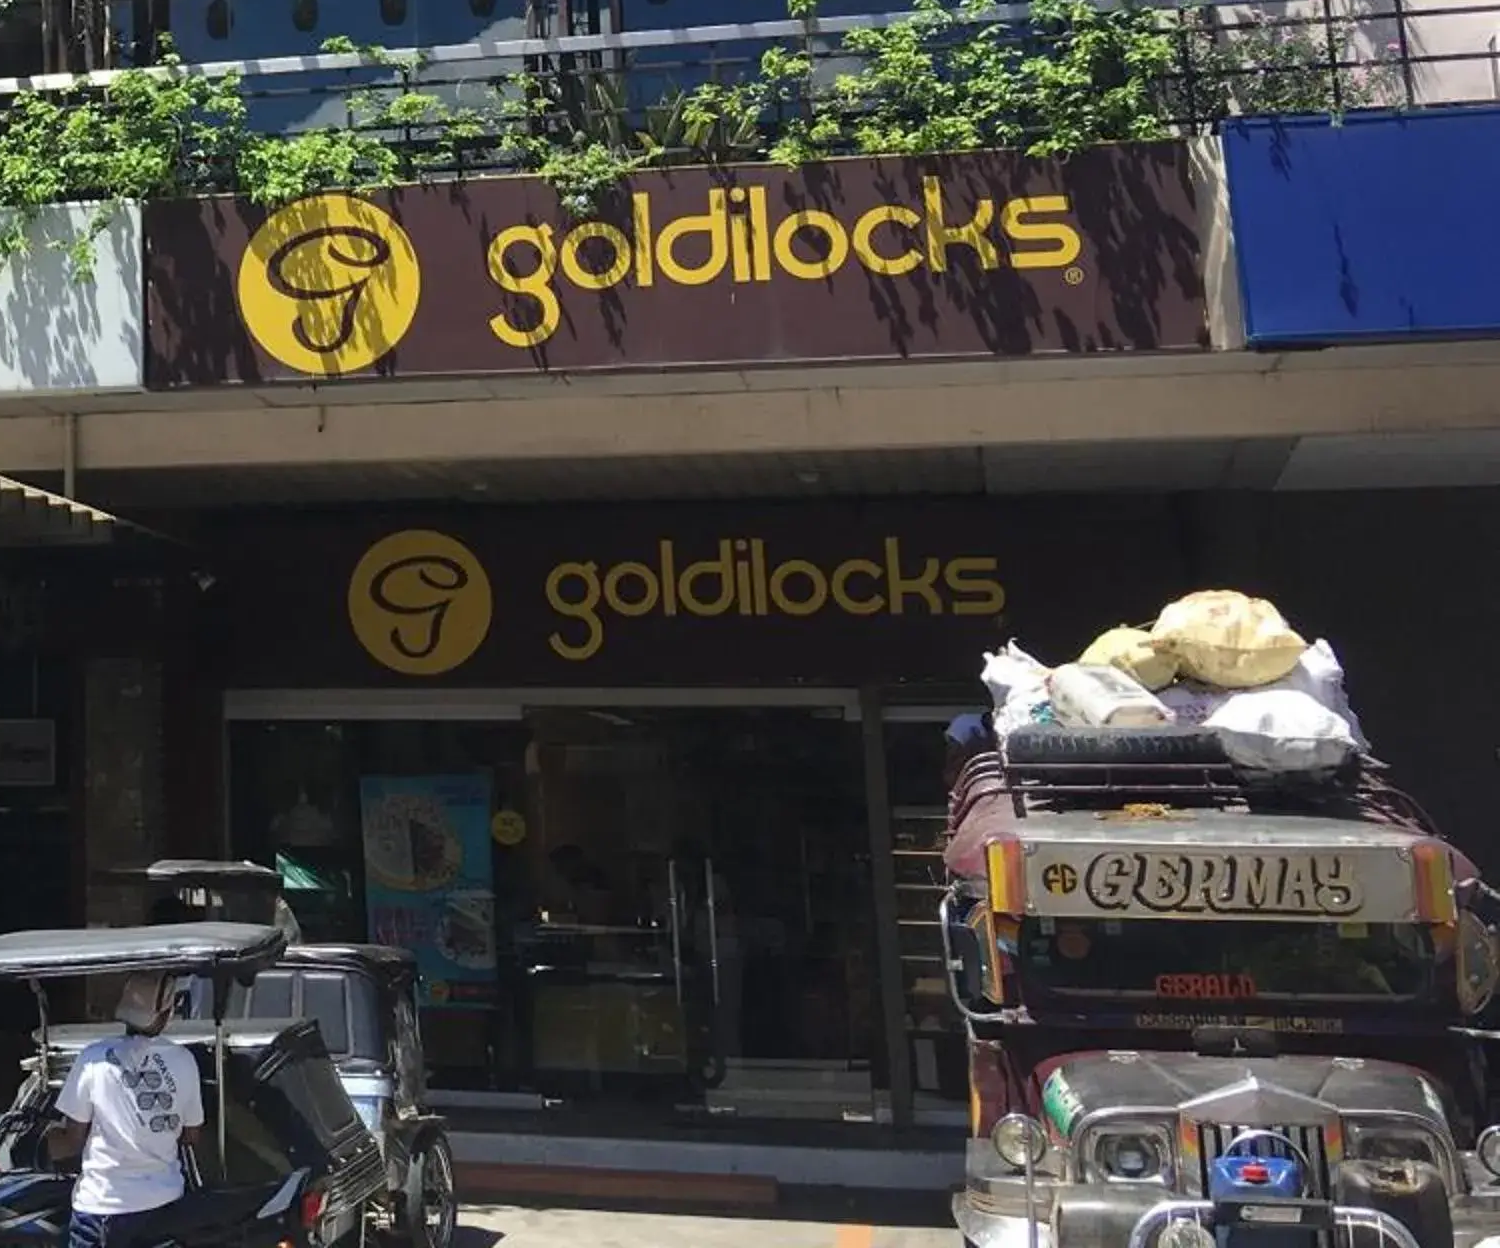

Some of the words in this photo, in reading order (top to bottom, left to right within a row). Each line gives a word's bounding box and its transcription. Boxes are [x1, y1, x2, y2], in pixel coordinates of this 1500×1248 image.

[487, 175, 1082, 350] goldilocks
[546, 539, 1004, 661] goldilocks
[1155, 973, 1257, 998] GERALD
